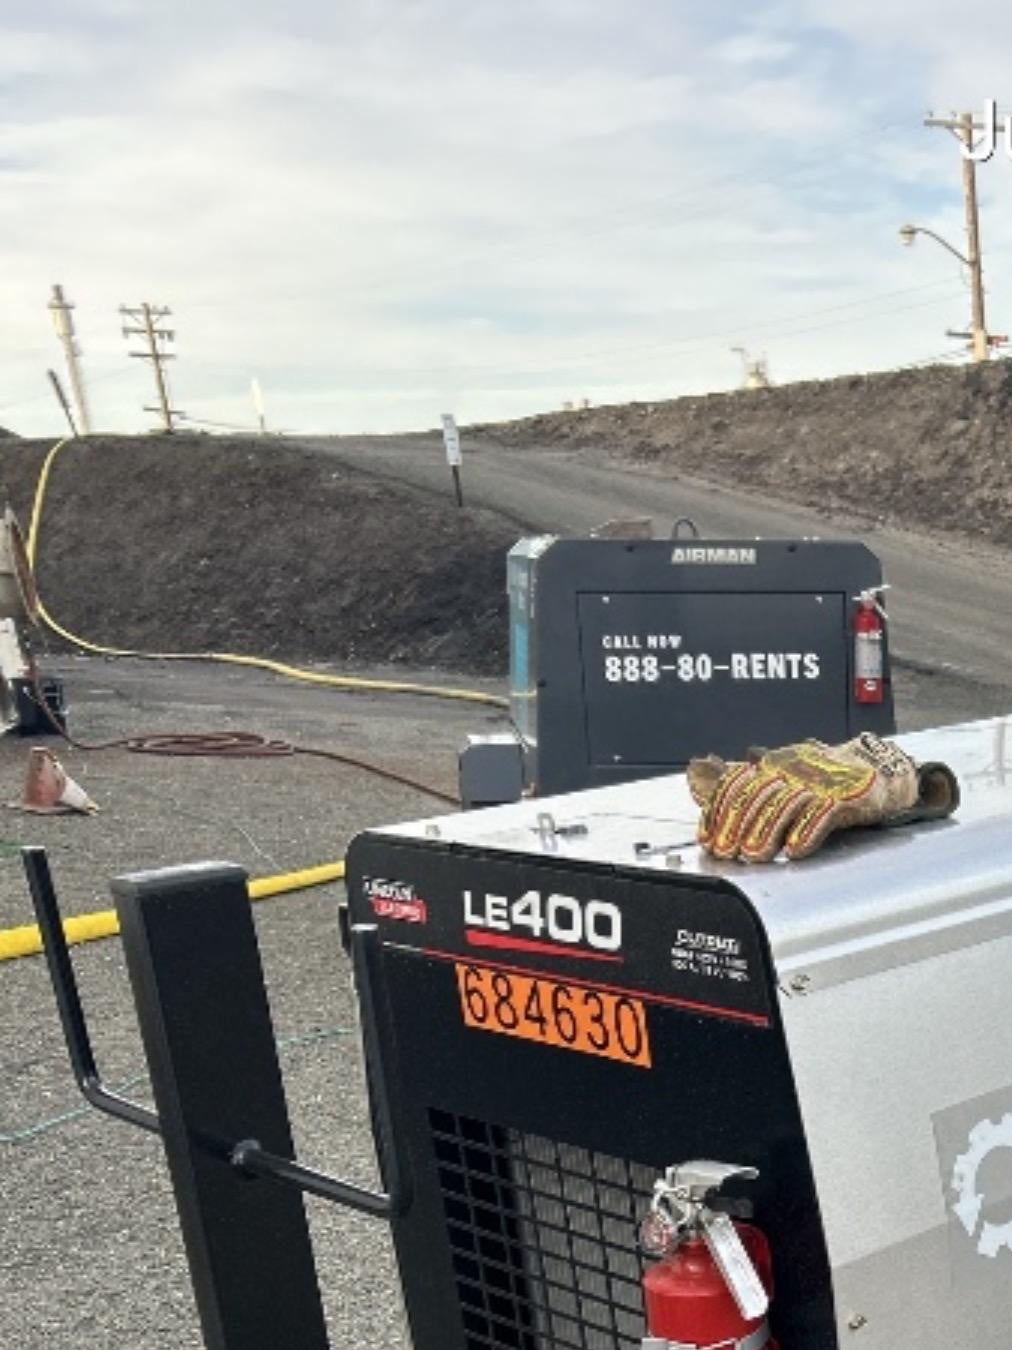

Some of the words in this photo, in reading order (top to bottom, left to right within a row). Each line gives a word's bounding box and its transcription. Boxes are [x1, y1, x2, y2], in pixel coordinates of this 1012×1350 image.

[671, 548, 757, 565] AIRMAN
[602, 635, 642, 649] CALL
[604, 653, 820, 682] 888-80-RENTS
[463, 889, 622, 950] LE400
[462, 966, 644, 1059] 684630
